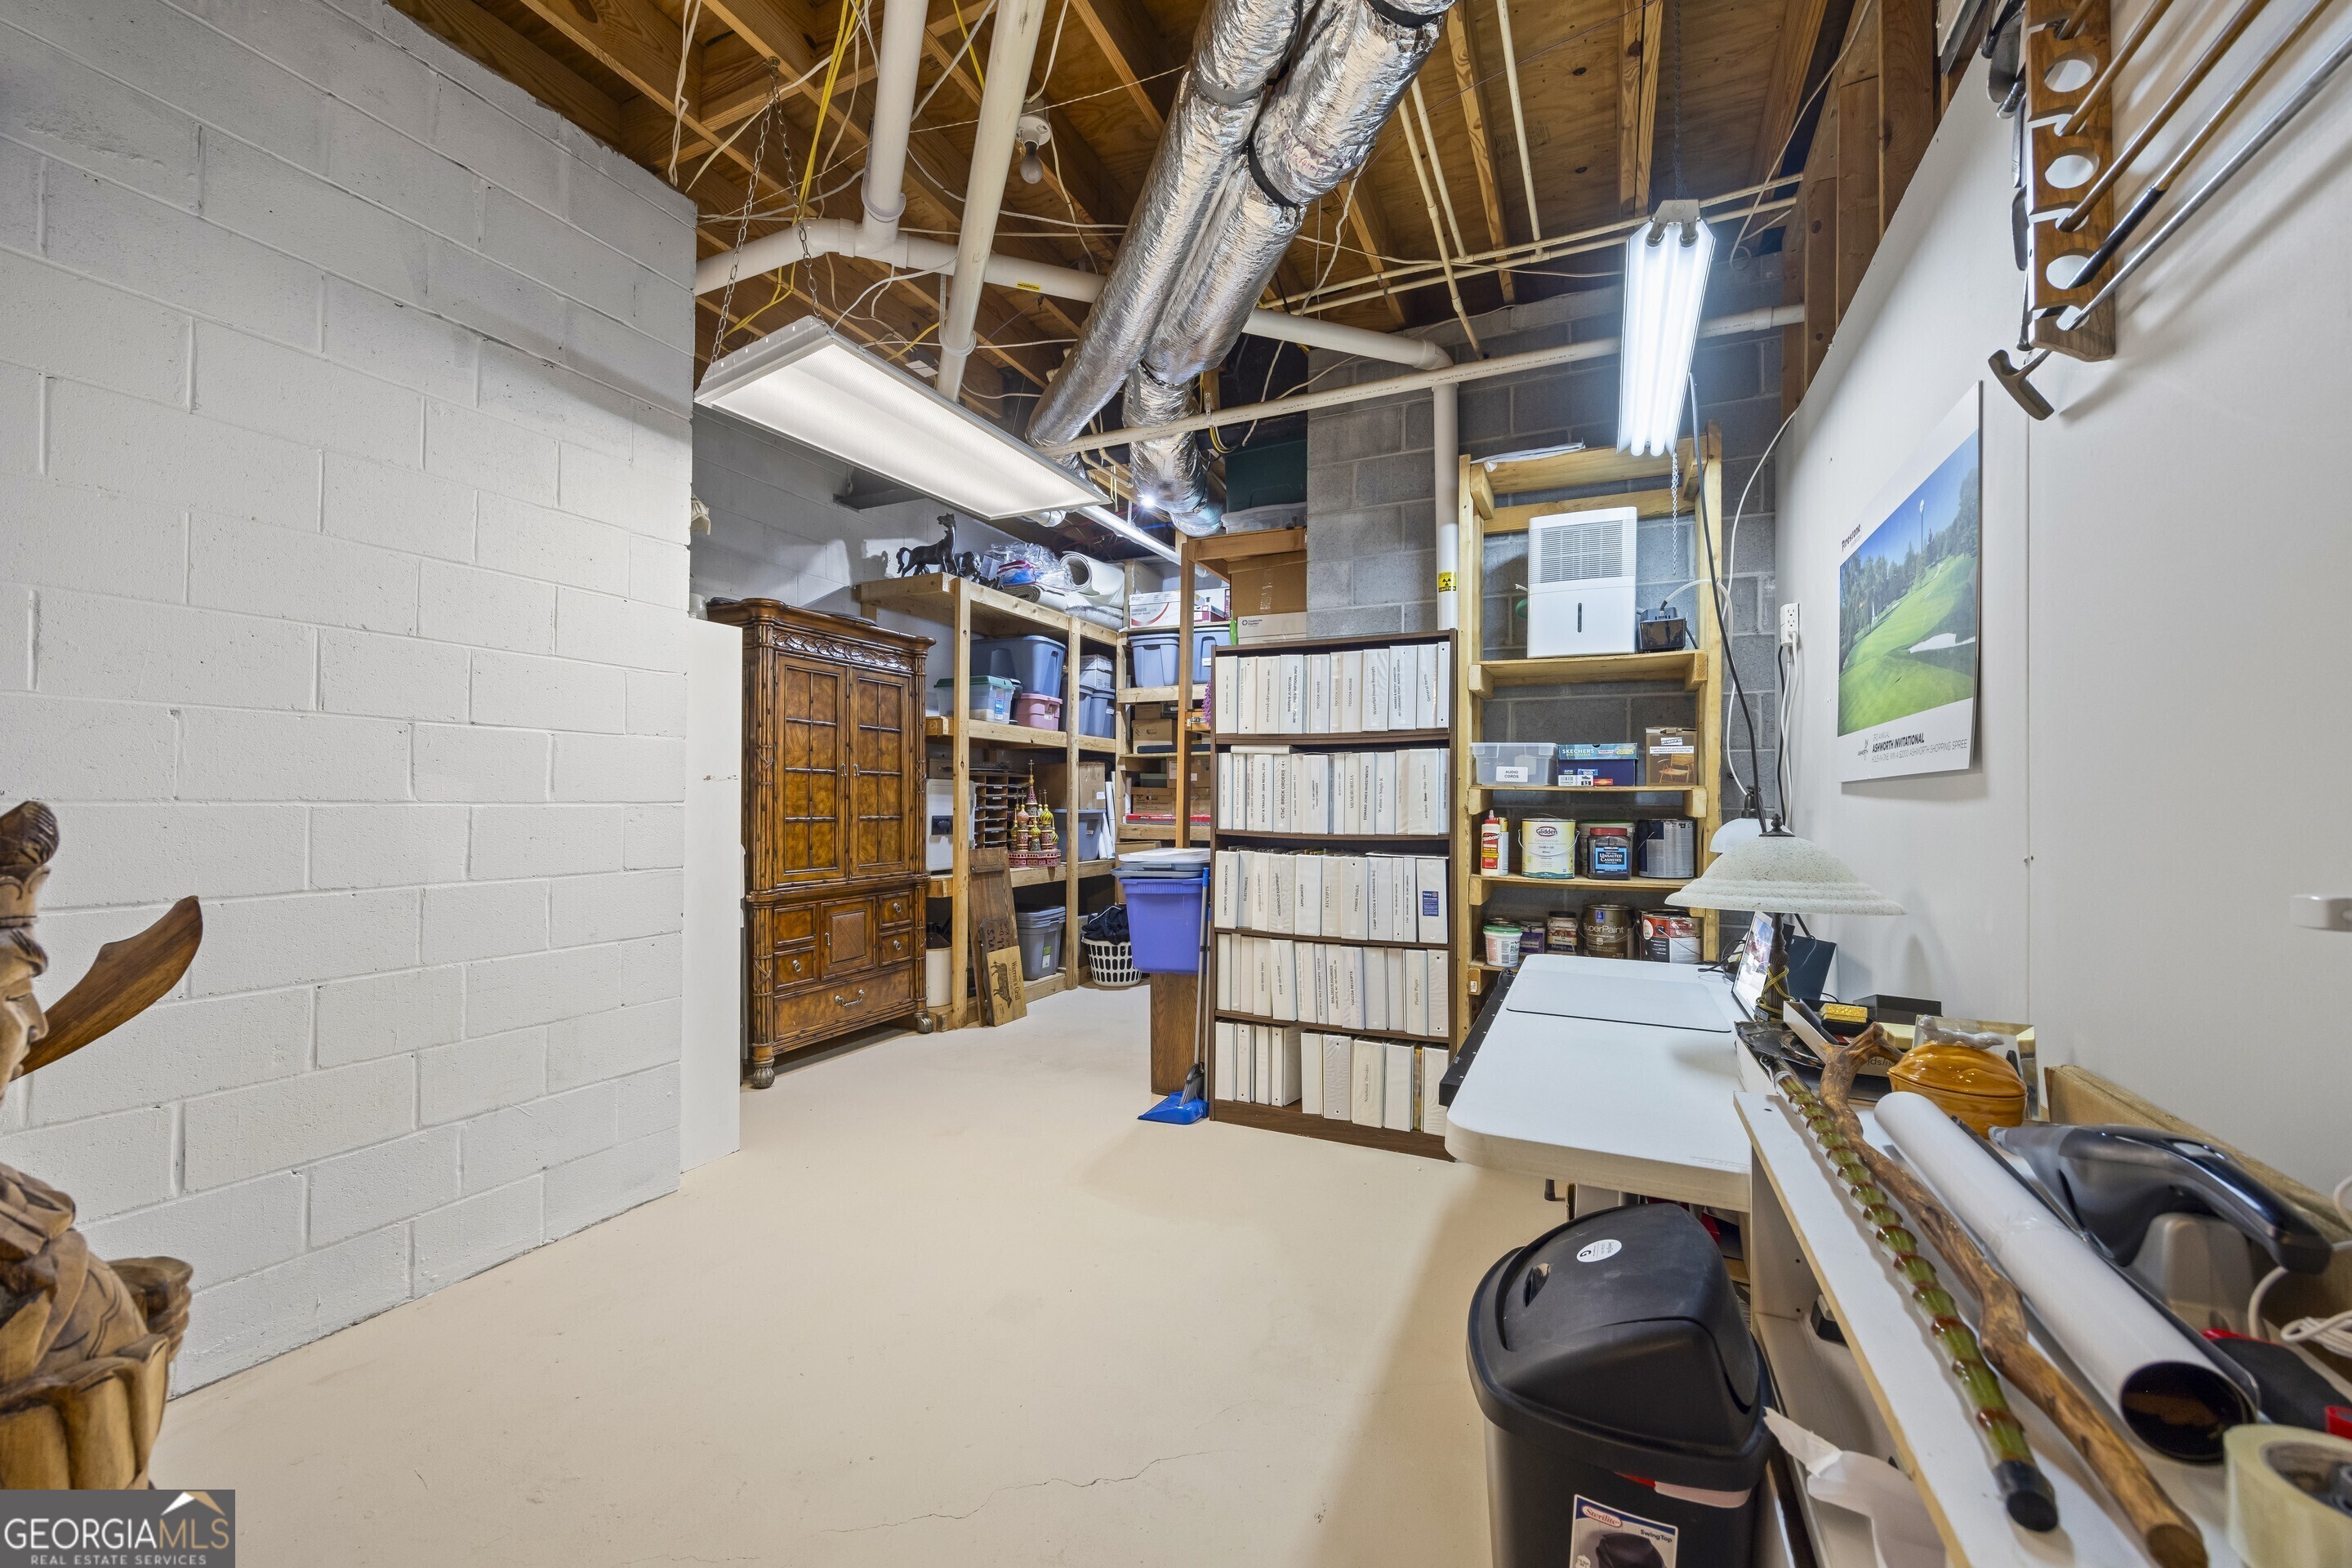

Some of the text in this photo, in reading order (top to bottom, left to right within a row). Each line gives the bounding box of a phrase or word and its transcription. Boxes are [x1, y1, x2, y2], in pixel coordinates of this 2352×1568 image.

[1842, 523, 1860, 552] Firestone
[1873, 733, 1924, 753] ASHWORTH INVITATIONAL
[1930, 741, 1952, 754] SHOPPING
[1952, 738, 1968, 751] SPREE
[1583, 922, 1624, 933] SuperPaint
[1579, 1250, 1592, 1258] G
[1585, 1508, 1618, 1526] Sterilite
[1640, 1529, 1673, 1544] SwingTop
